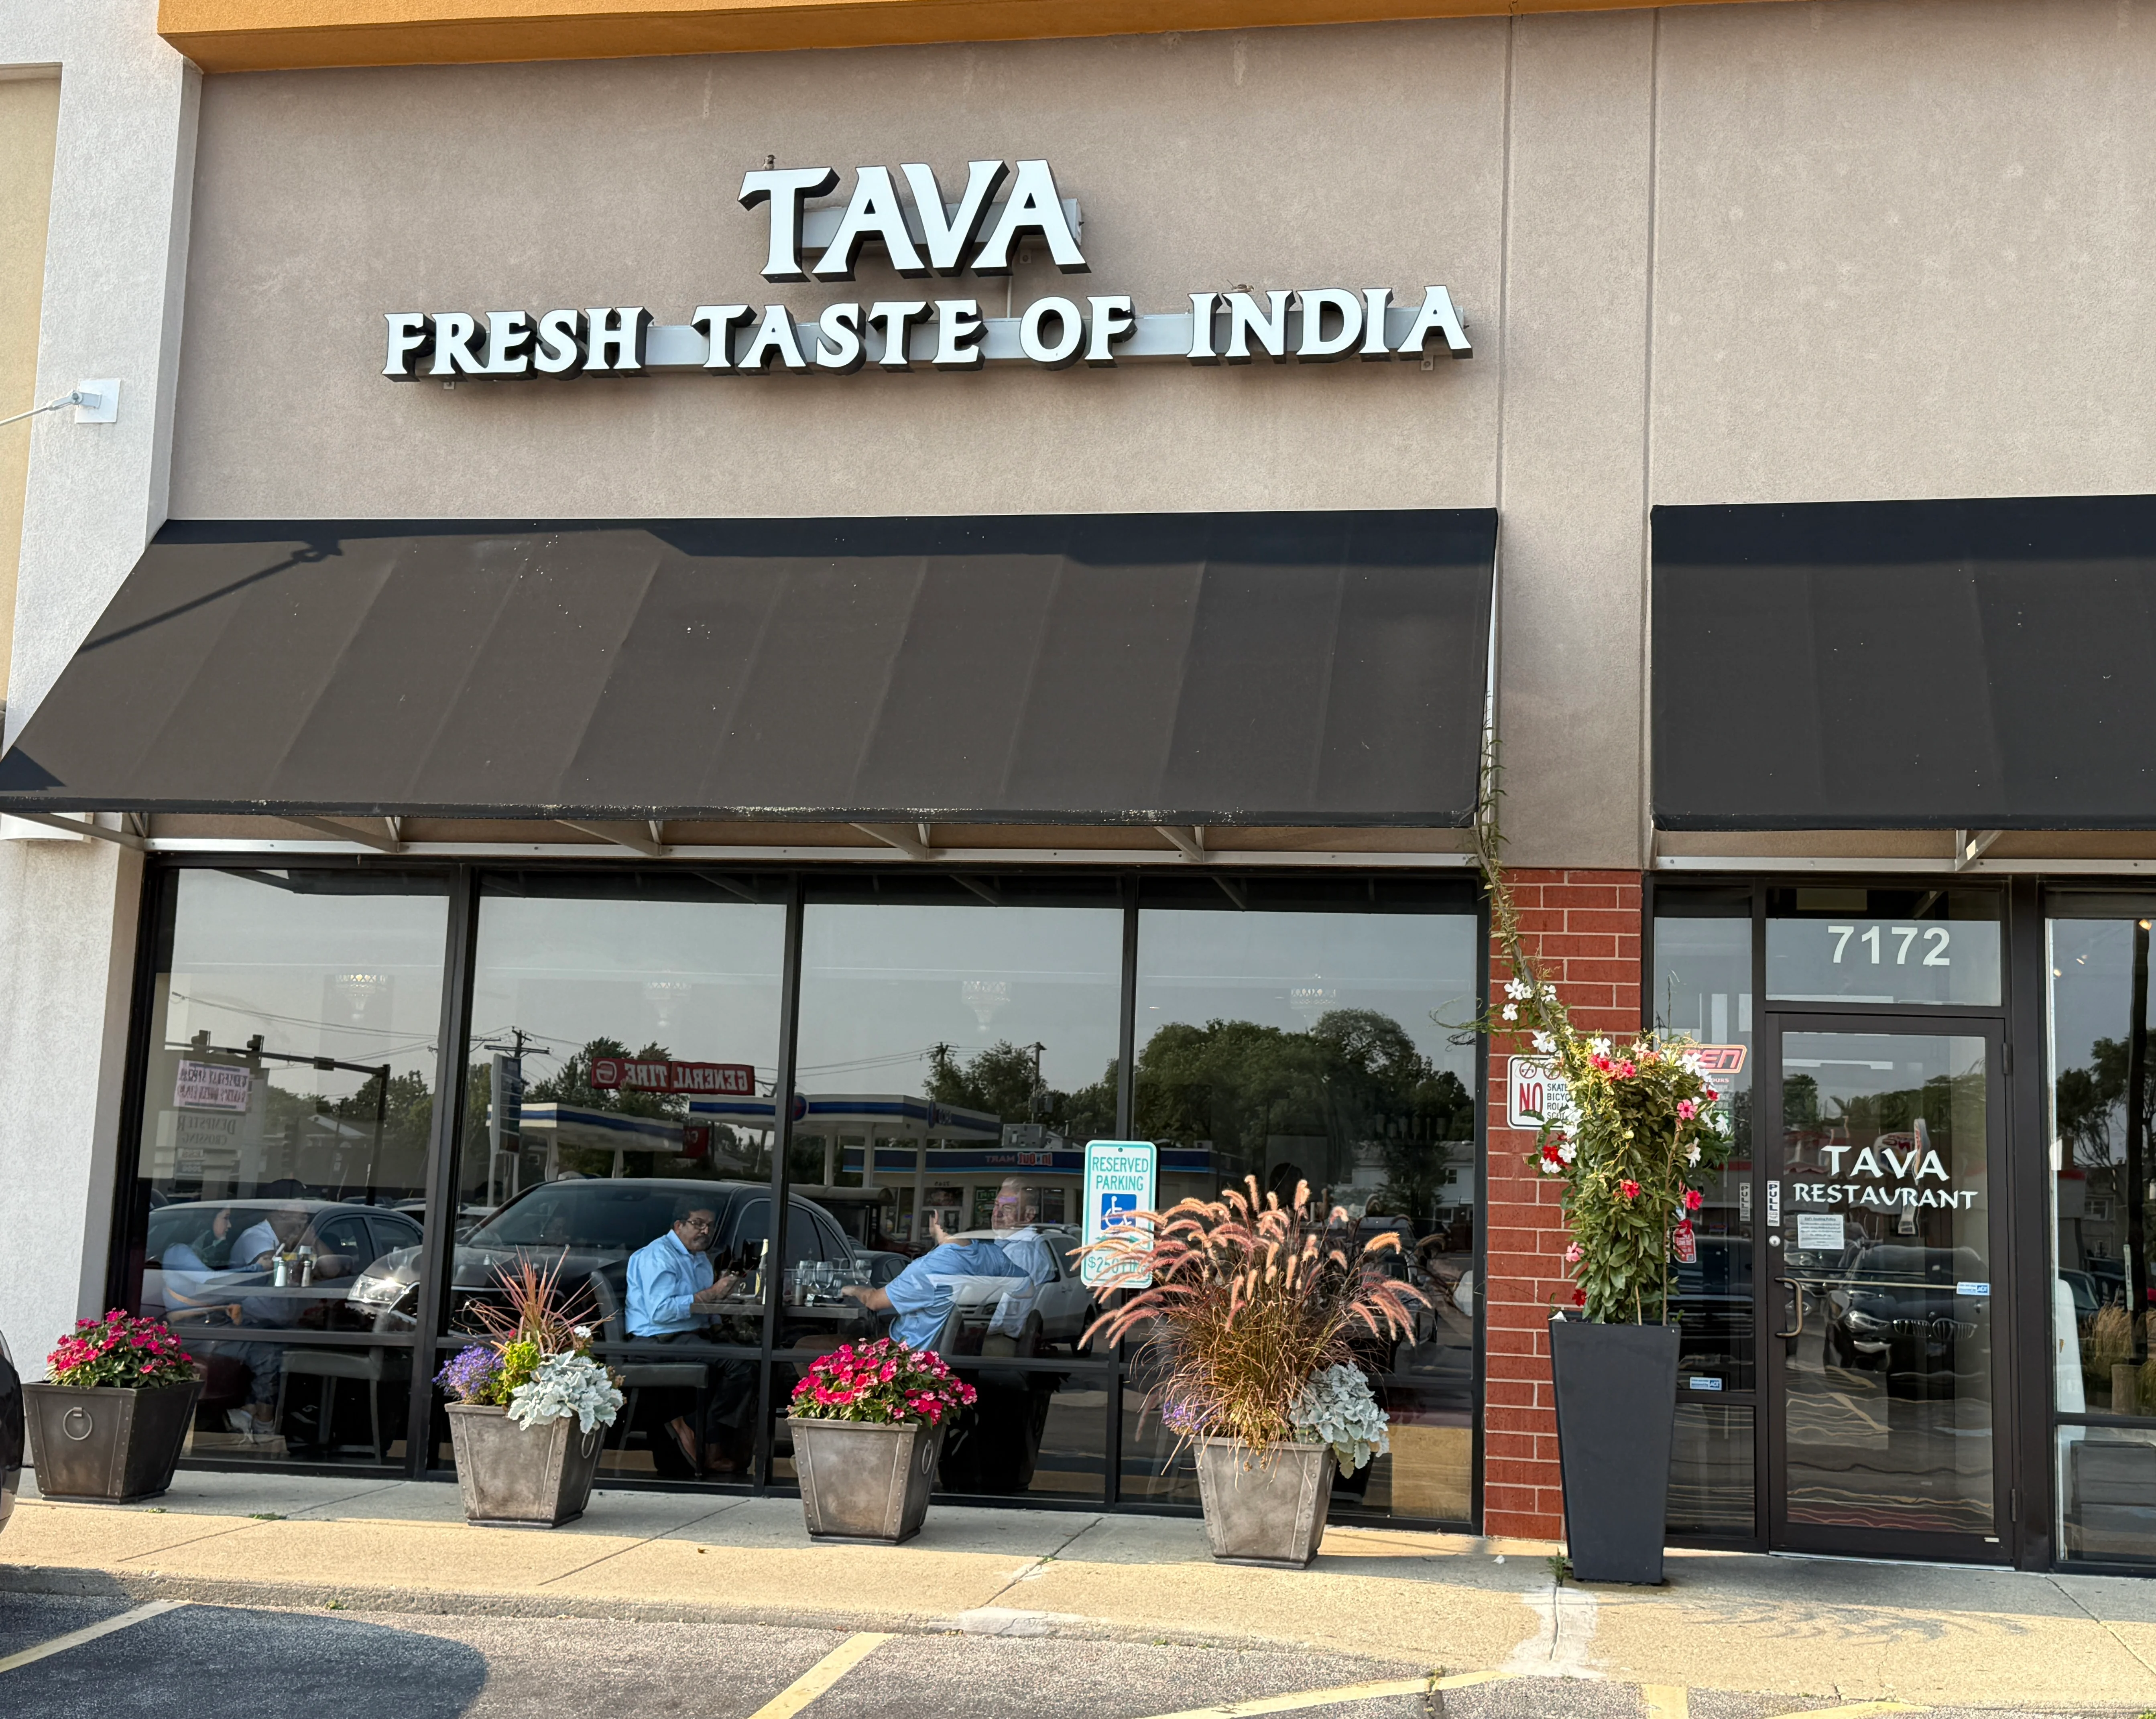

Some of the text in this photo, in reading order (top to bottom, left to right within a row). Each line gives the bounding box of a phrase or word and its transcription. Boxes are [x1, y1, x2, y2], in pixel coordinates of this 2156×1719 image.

[738, 159, 1086, 276] TAVA
[382, 285, 1472, 375] FRESH TASTE OF INDIA
[1828, 925, 1951, 967] 7172
[1519, 1082, 1543, 1115] NO
[1547, 1083, 1568, 1091] SKATE
[1092, 1156, 1149, 1173] RESERVED
[1821, 1145, 1950, 1181] TAVA
[1096, 1175, 1144, 1191] PARKING
[1793, 1183, 1979, 1209] RESTAURANT
[1741, 1185, 1749, 1209] PULL
[1769, 1184, 1778, 1211] PULL
